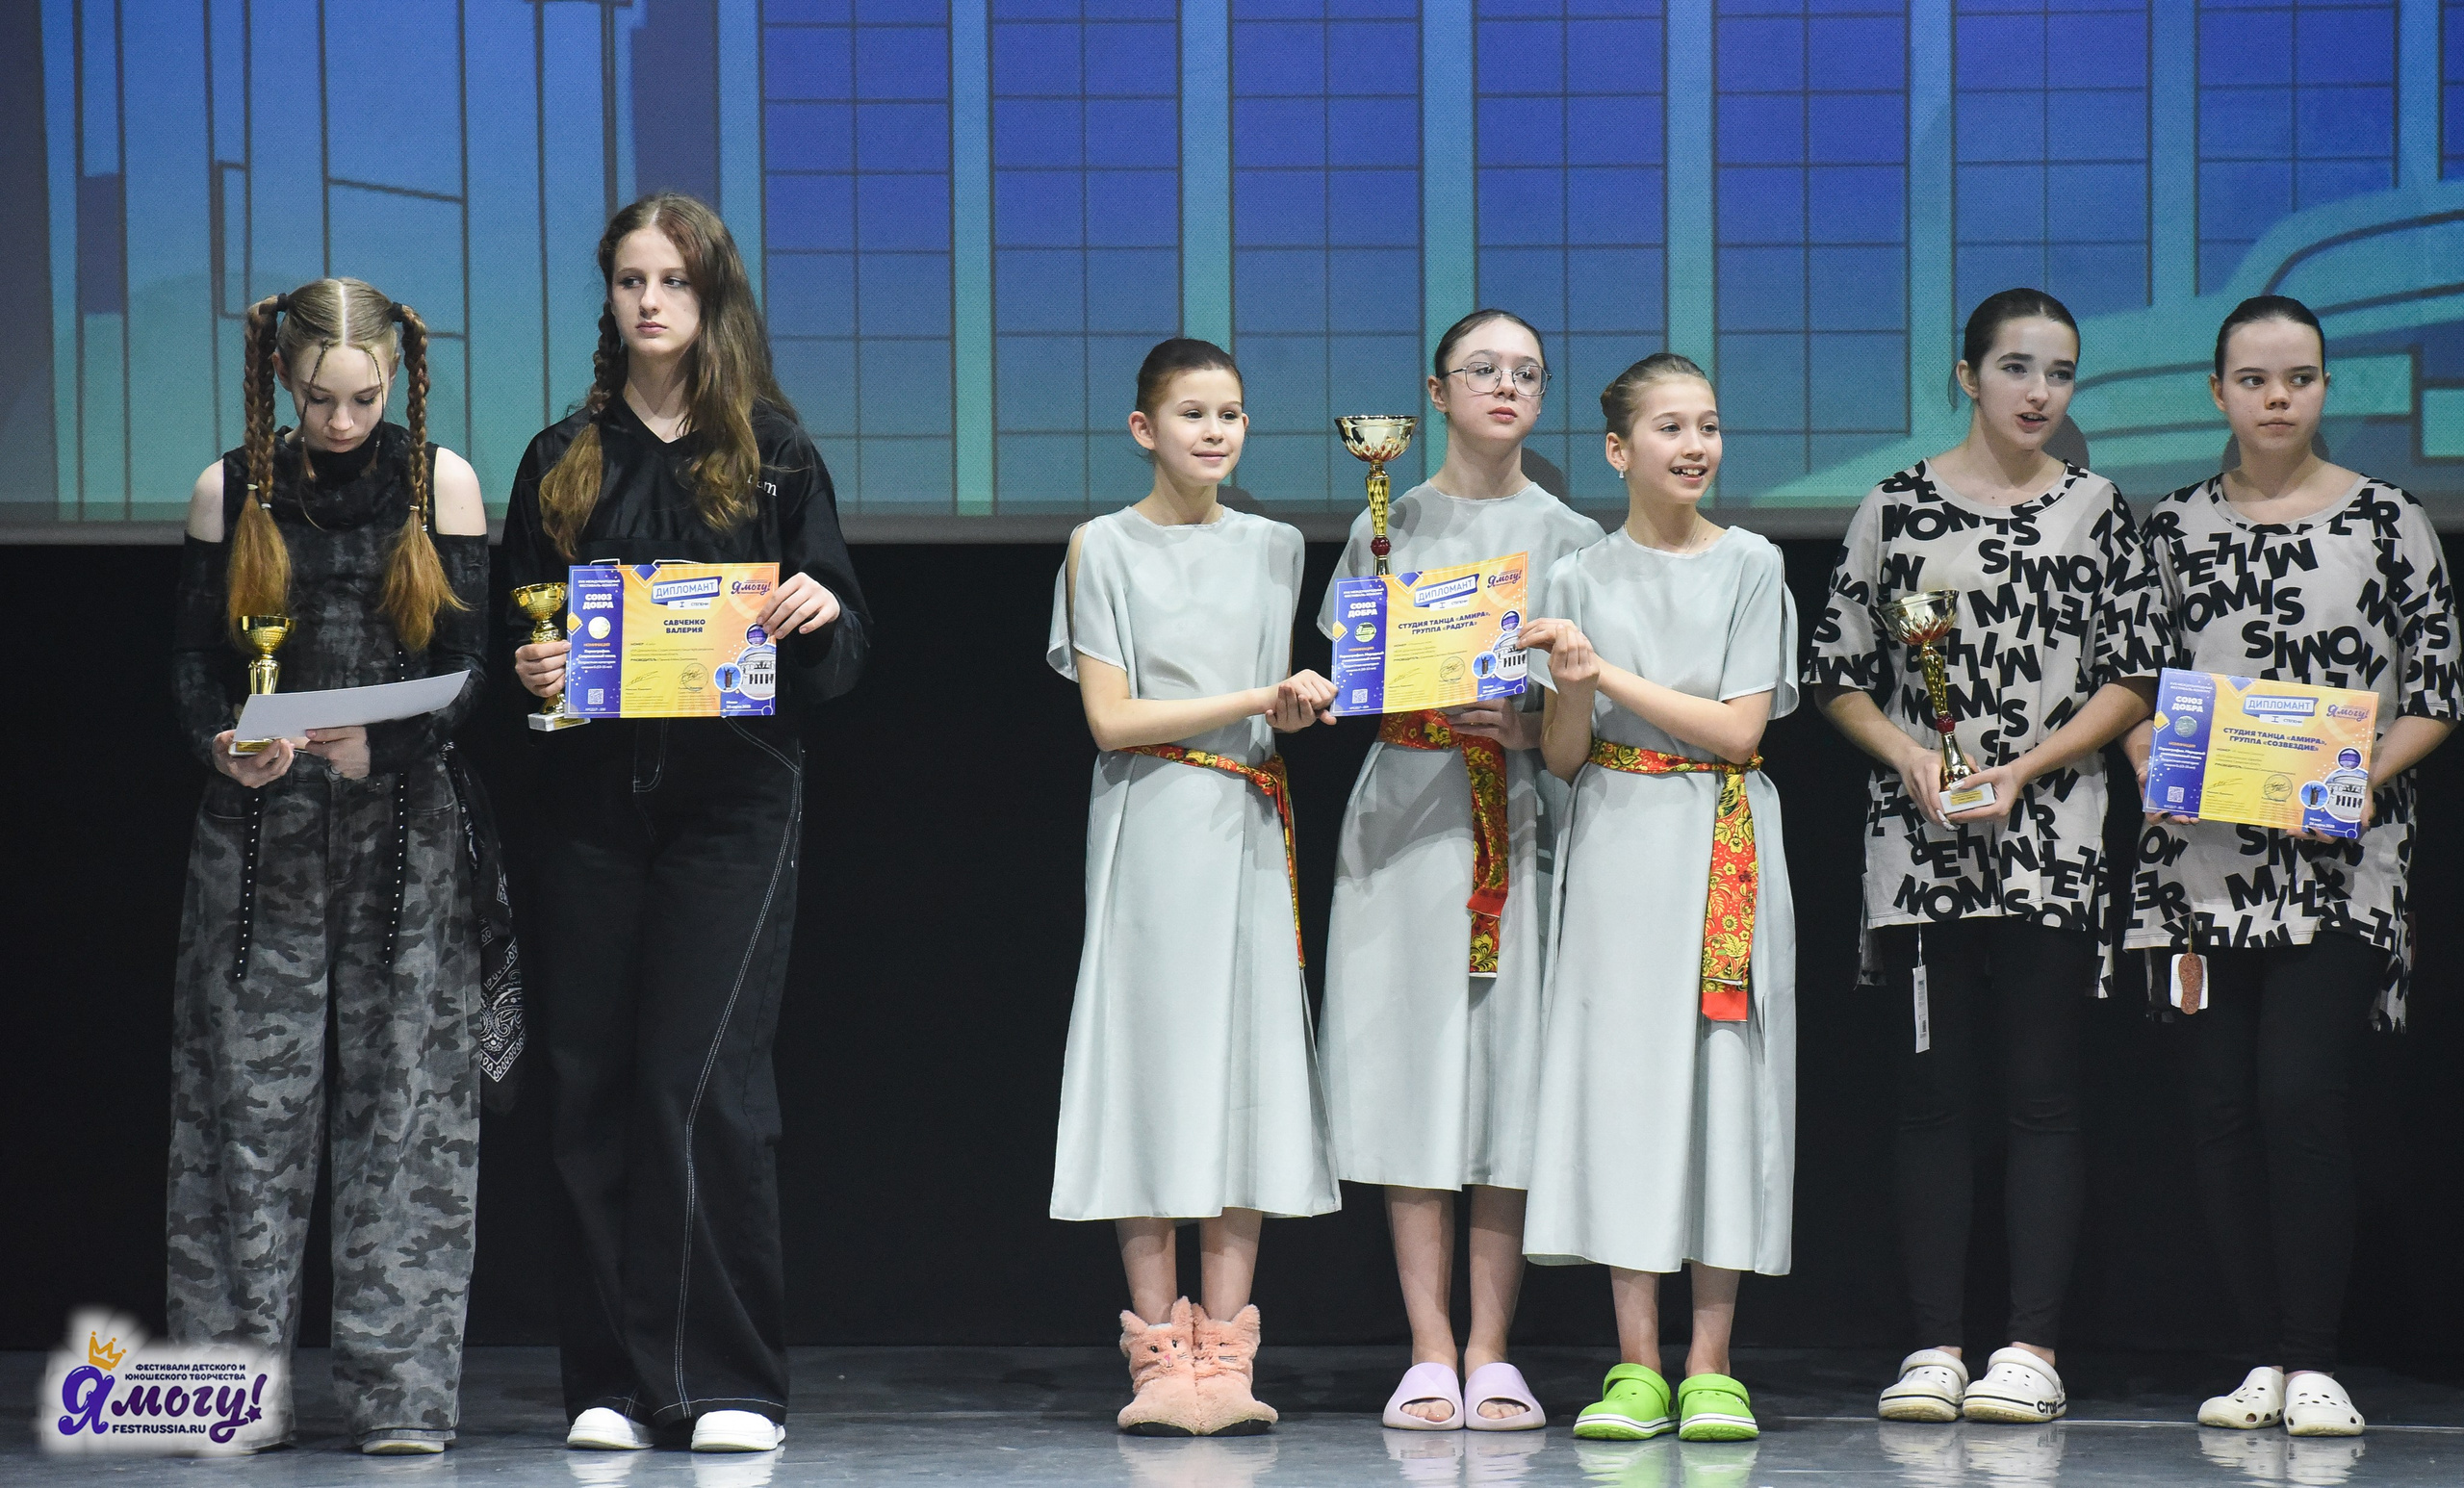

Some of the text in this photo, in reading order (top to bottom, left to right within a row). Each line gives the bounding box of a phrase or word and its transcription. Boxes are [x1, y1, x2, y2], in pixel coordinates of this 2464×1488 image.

[655, 582, 714, 597] ДИПЛОМАНТ
[1418, 578, 1474, 602] ДИПЛОМАНТ
[2179, 572, 2305, 632] OMIS
[1348, 608, 1378, 618] ДОБРА
[1399, 621, 1428, 629] СТУДИЯ
[1429, 617, 1454, 626] ТАНЦА
[1412, 621, 1477, 634] ГРУППА «РАДУГА»
[2175, 696, 2203, 705] СОЮЗ
[2248, 700, 2310, 710] ДИПЛОМАНТ
[2171, 703, 2203, 712] ДОБРА
[2223, 728, 2256, 736] СТУДИЯ
[2257, 731, 2285, 740] ТАНЦА
[2229, 735, 2319, 751] ГРУППА «СОЗВЕЗДИЕ»
